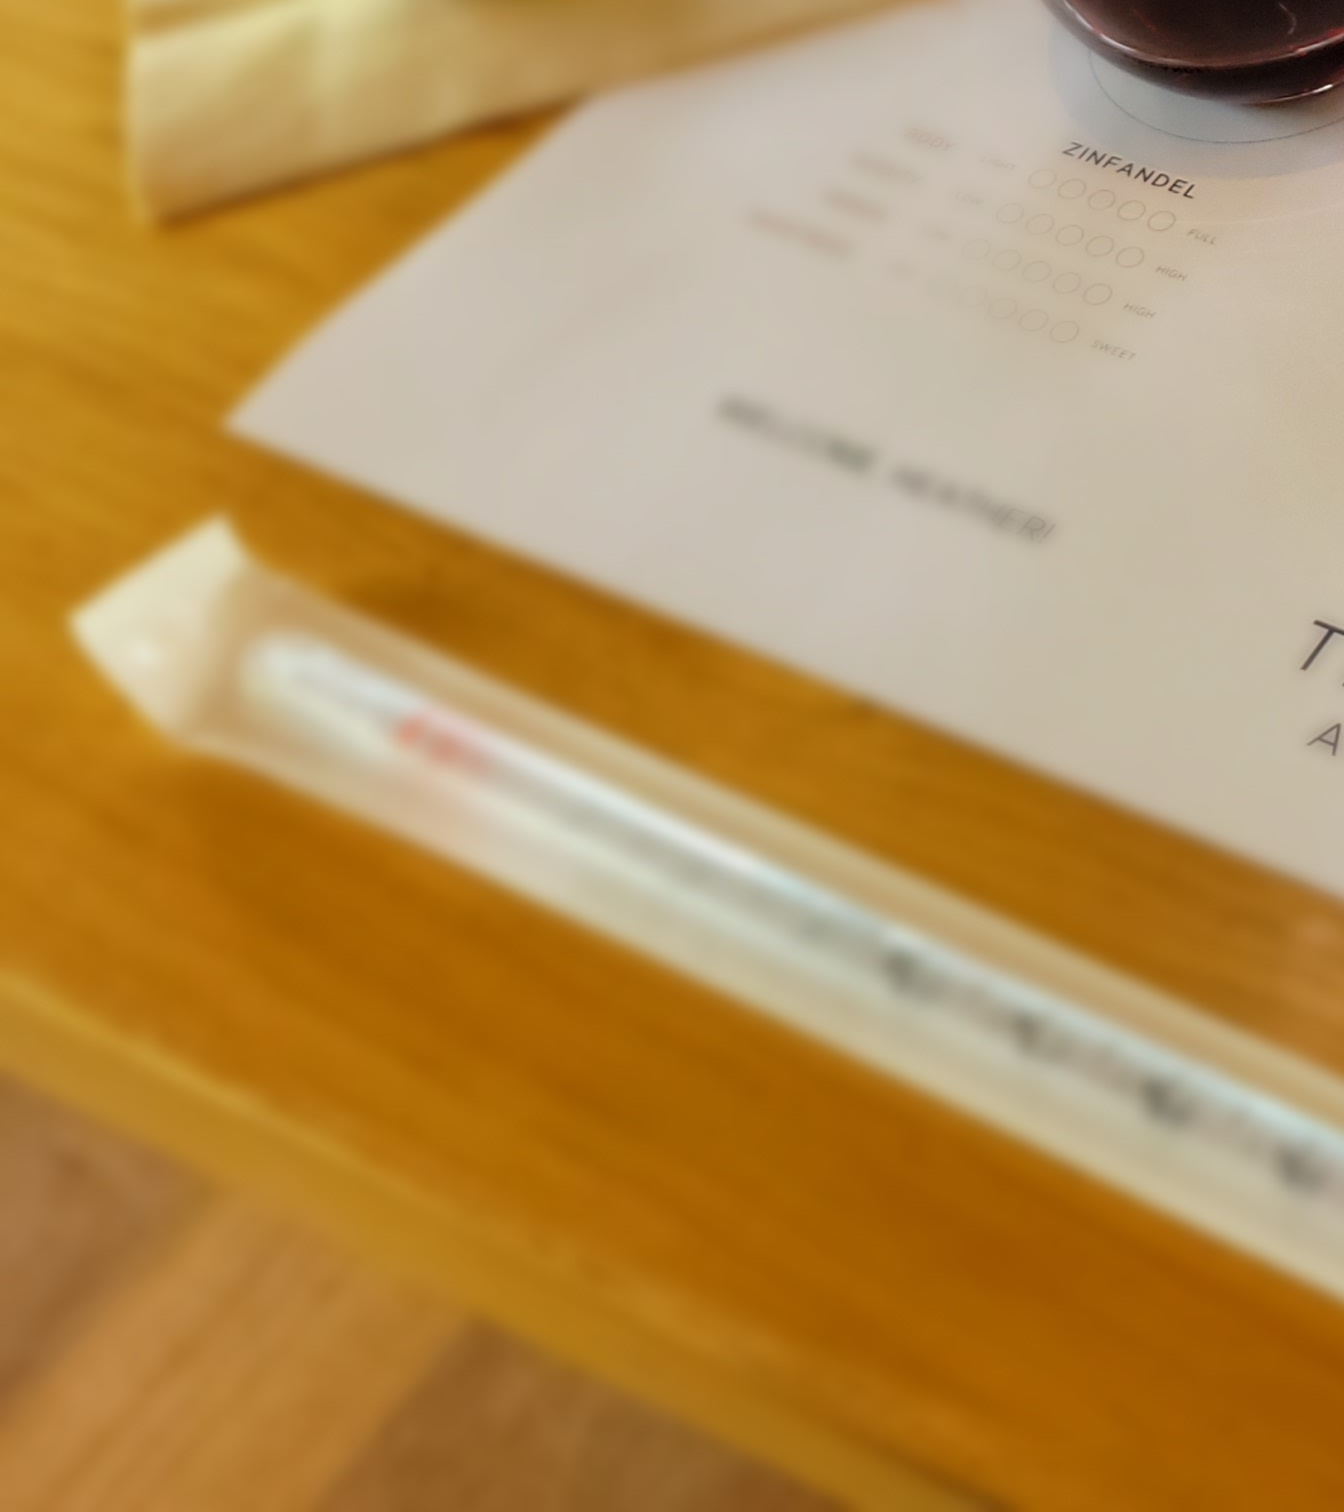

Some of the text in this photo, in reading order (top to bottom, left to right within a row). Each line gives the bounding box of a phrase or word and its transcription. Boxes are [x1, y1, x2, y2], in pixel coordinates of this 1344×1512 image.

[1062, 141, 1199, 200] ZINFANDEL
[1187, 227, 1218, 246] FULL
[1155, 265, 1189, 283] HIGH
[1122, 301, 1157, 320] HIGH
[1090, 339, 1138, 363] SWEET
